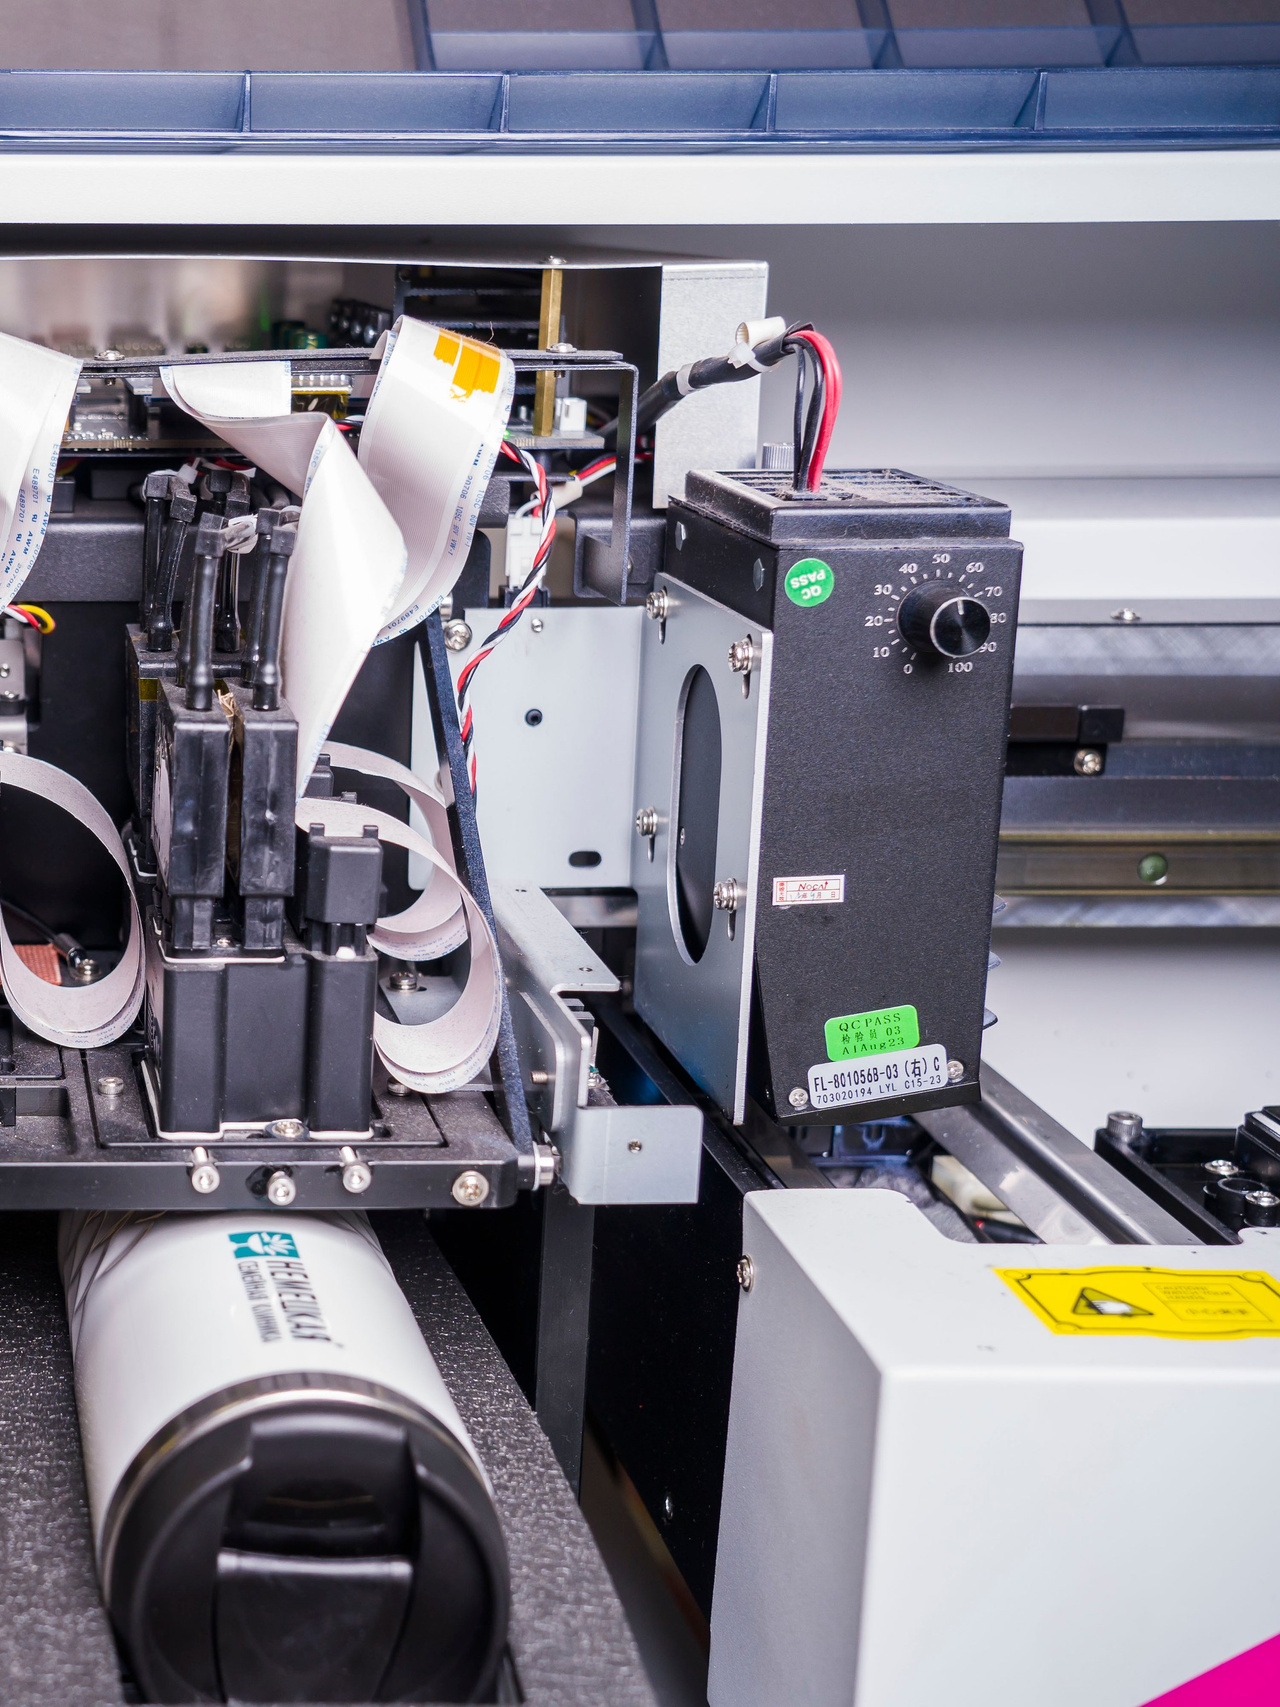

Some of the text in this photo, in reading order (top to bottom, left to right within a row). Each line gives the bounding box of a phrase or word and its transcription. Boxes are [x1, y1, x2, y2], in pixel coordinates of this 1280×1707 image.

[47, 443, 59, 483] E489701
[31, 468, 40, 504] E489701
[18, 488, 26, 523] E489701
[455, 505, 463, 521] 105C
[40, 511, 49, 535] AWM
[23, 531, 33, 555] AWM
[4, 550, 16, 574] AWM
[932, 553, 951, 564] 50
[966, 562, 984, 573] 60
[6, 563, 21, 588] 20706
[899, 563, 918, 574] 40
[790, 569, 826, 589] PASS
[801, 585, 822, 600] QC
[874, 584, 892, 596] 30
[985, 586, 1003, 597] 70
[387, 604, 419, 629] E489701
[415, 595, 444, 623] E489701
[865, 616, 884, 627] 20
[990, 613, 1007, 624] 80
[873, 647, 890, 658] 10
[979, 642, 997, 652] 90
[903, 664, 913, 674] 0
[948, 662, 973, 673] 100
[839, 1012, 901, 1032] QC PASS
[885, 1025, 901, 1036] 03
[814, 1063, 899, 1092] FL-801056B-03
[933, 1056, 940, 1071] C
[817, 1075, 942, 1104] 703020194 LYL C15-23
[266, 1260, 331, 1341] НЕМЕЦКАЯ
